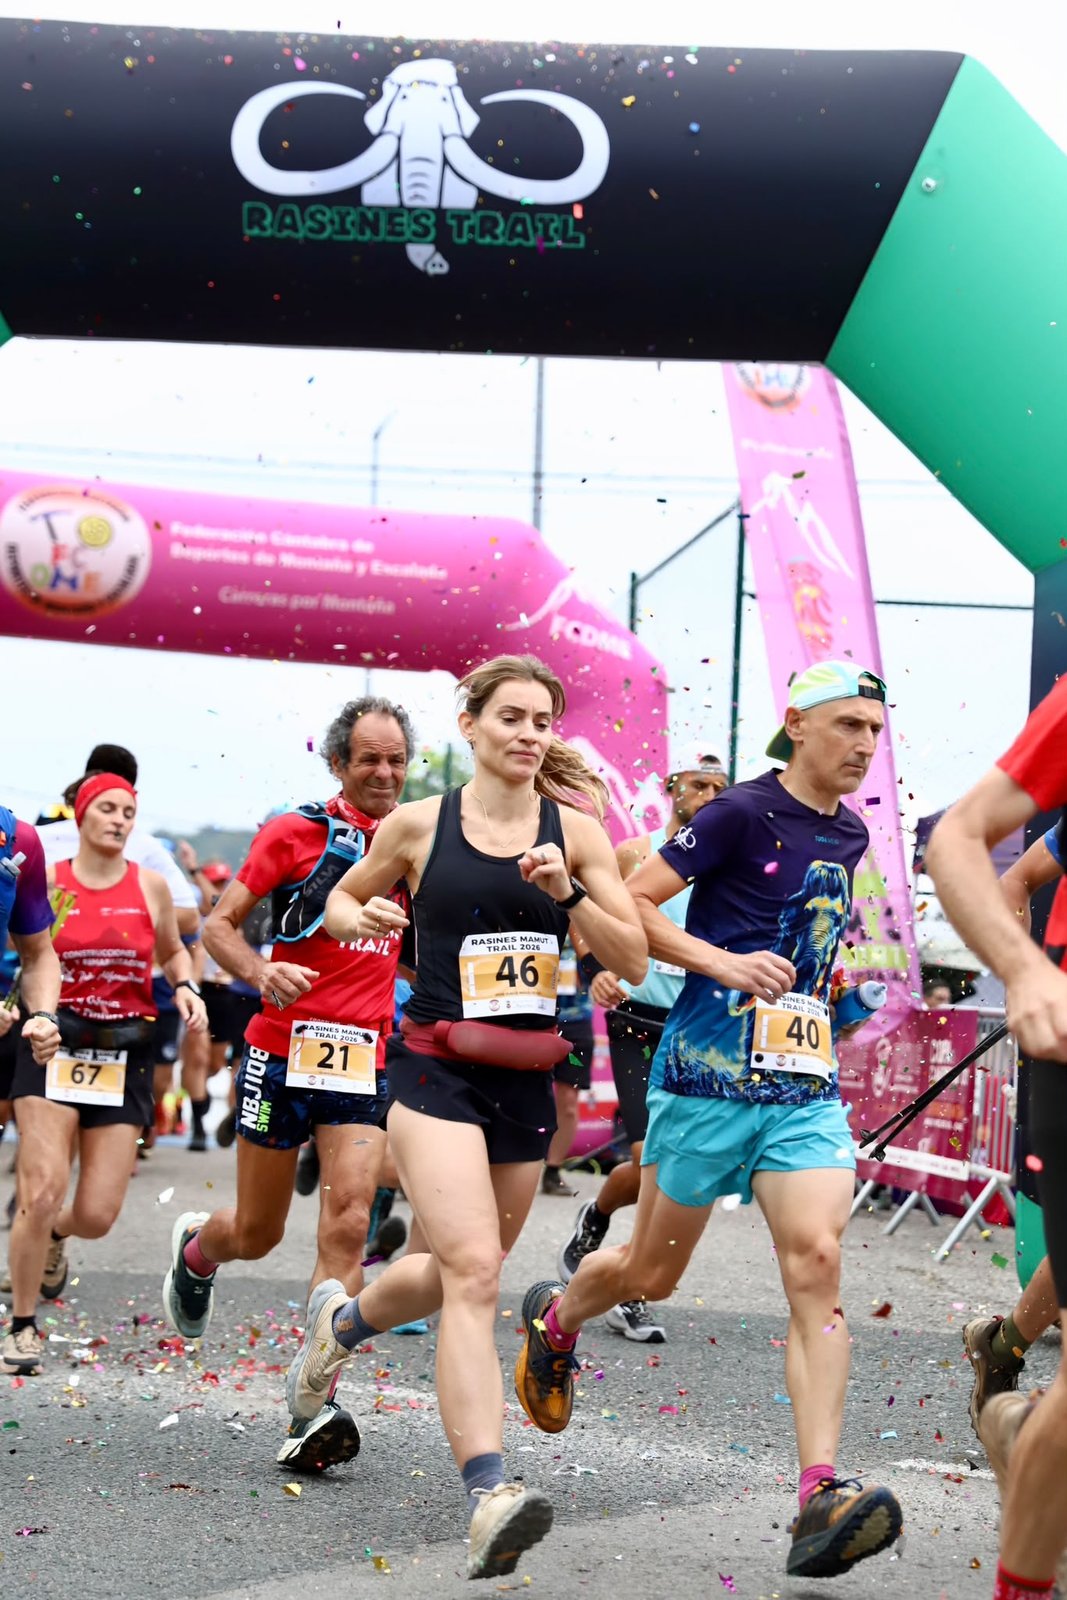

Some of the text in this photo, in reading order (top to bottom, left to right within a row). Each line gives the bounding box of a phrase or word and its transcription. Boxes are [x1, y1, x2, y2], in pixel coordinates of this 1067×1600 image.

[241, 200, 586, 249] RASINES TRAIL
[471, 936, 549, 946] RASINES MAMUT
[486, 944, 517, 953] TRAIL
[495, 955, 539, 988] 46
[782, 1002, 805, 1012] TRAIL
[314, 1031, 358, 1043] TRAIL 2026
[786, 1015, 820, 1049] 40
[316, 1042, 350, 1071] 21
[71, 1062, 102, 1085] 67
[256, 1100, 272, 1133] SWIM
